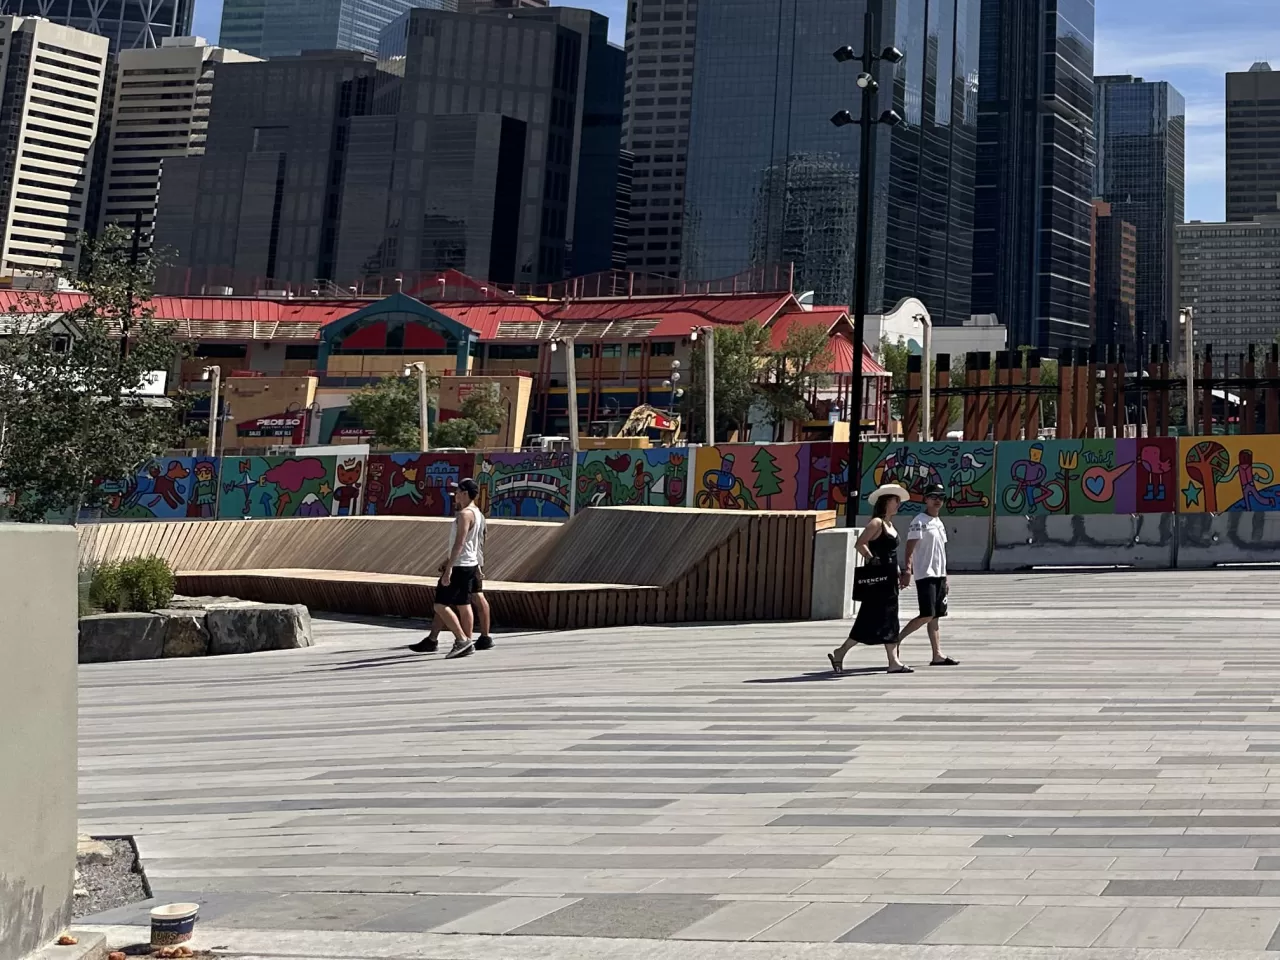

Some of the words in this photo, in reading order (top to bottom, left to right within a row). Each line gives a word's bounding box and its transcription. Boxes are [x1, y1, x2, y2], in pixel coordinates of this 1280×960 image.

[1081, 448, 1114, 464] This
[239, 458, 251, 474] N
[223, 480, 236, 495] W
[258, 475, 267, 487] E
[858, 576, 888, 584] GIVENCHY
